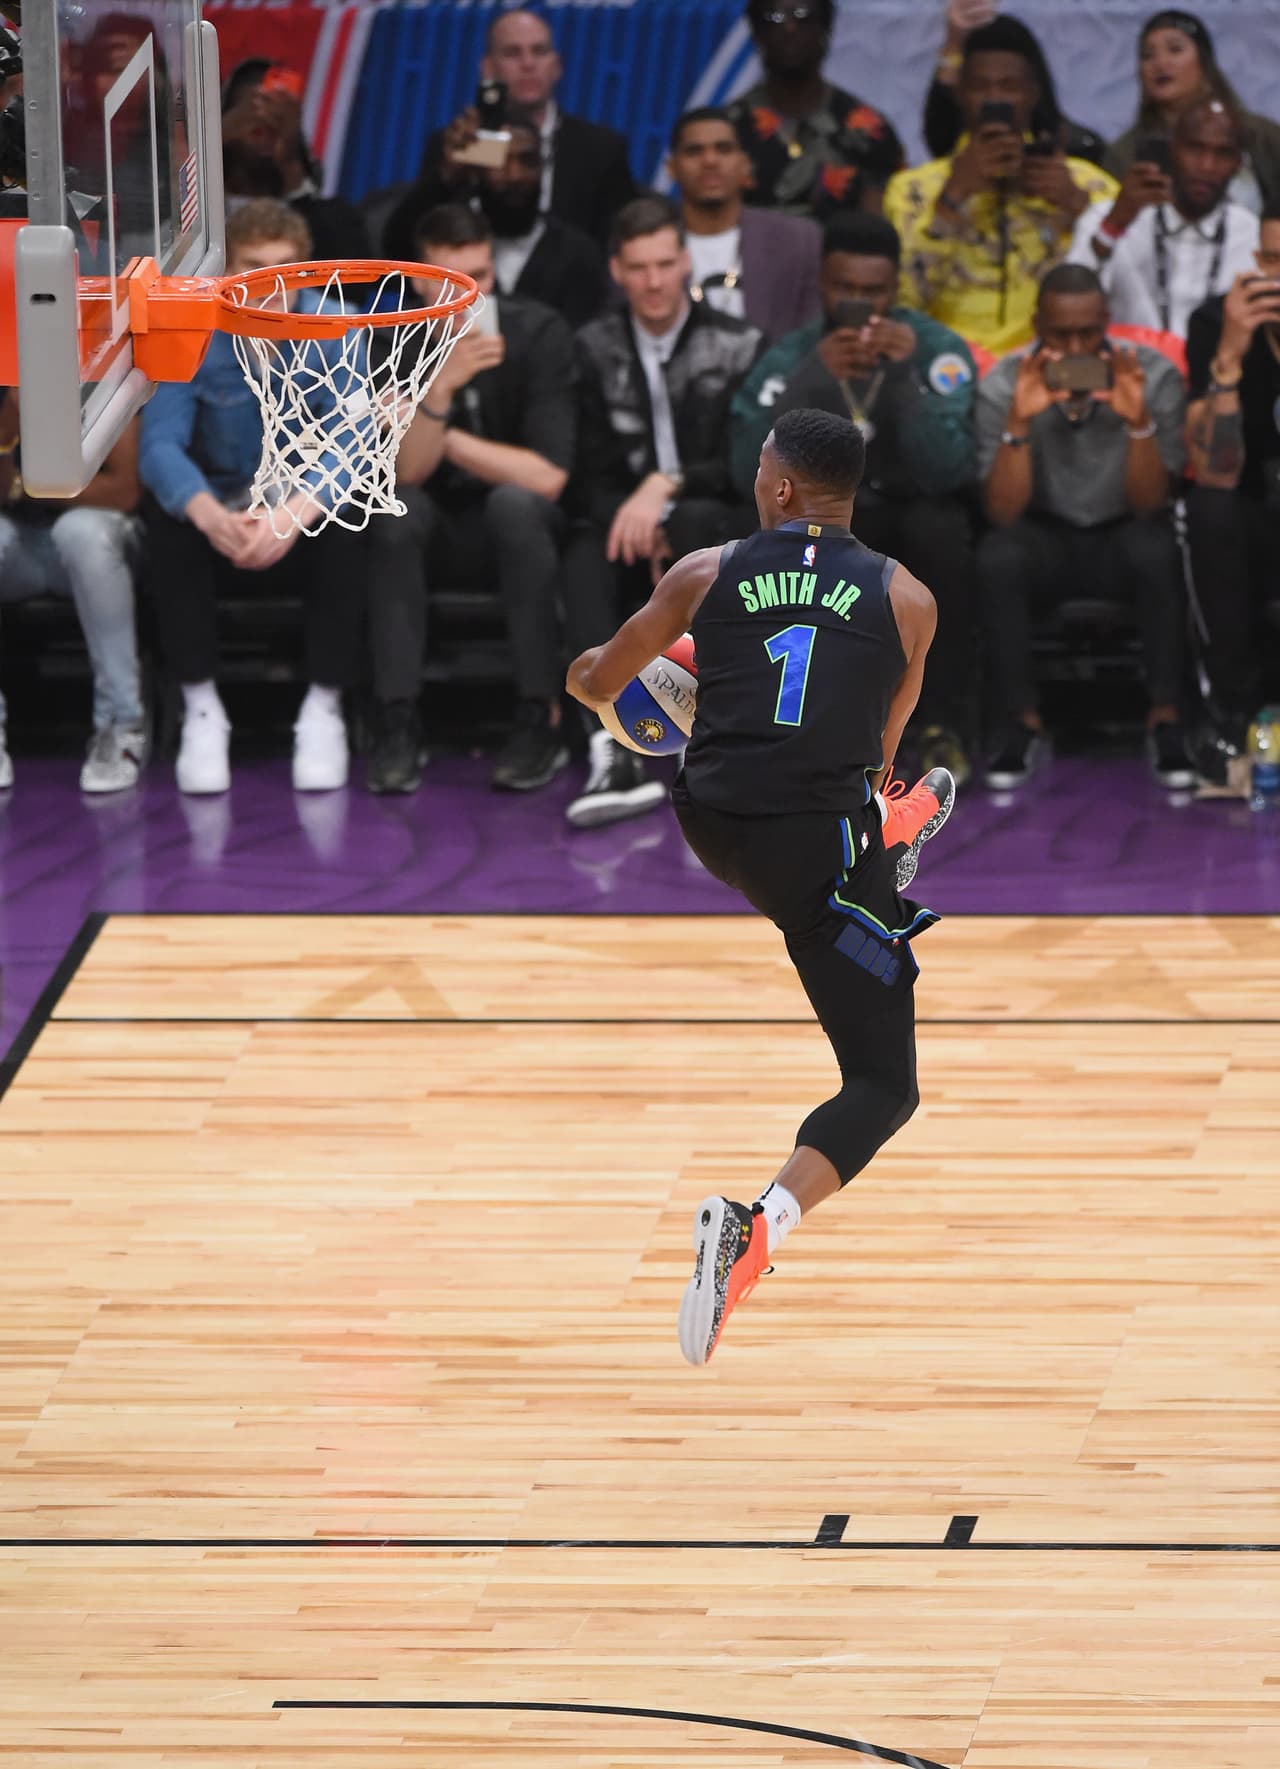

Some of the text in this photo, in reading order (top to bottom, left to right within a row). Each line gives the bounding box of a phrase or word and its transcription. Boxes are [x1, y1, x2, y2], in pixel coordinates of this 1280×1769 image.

[738, 571, 861, 621] SMITH JR.
[647, 667, 696, 714] SPALD
[763, 623, 818, 727] 1
